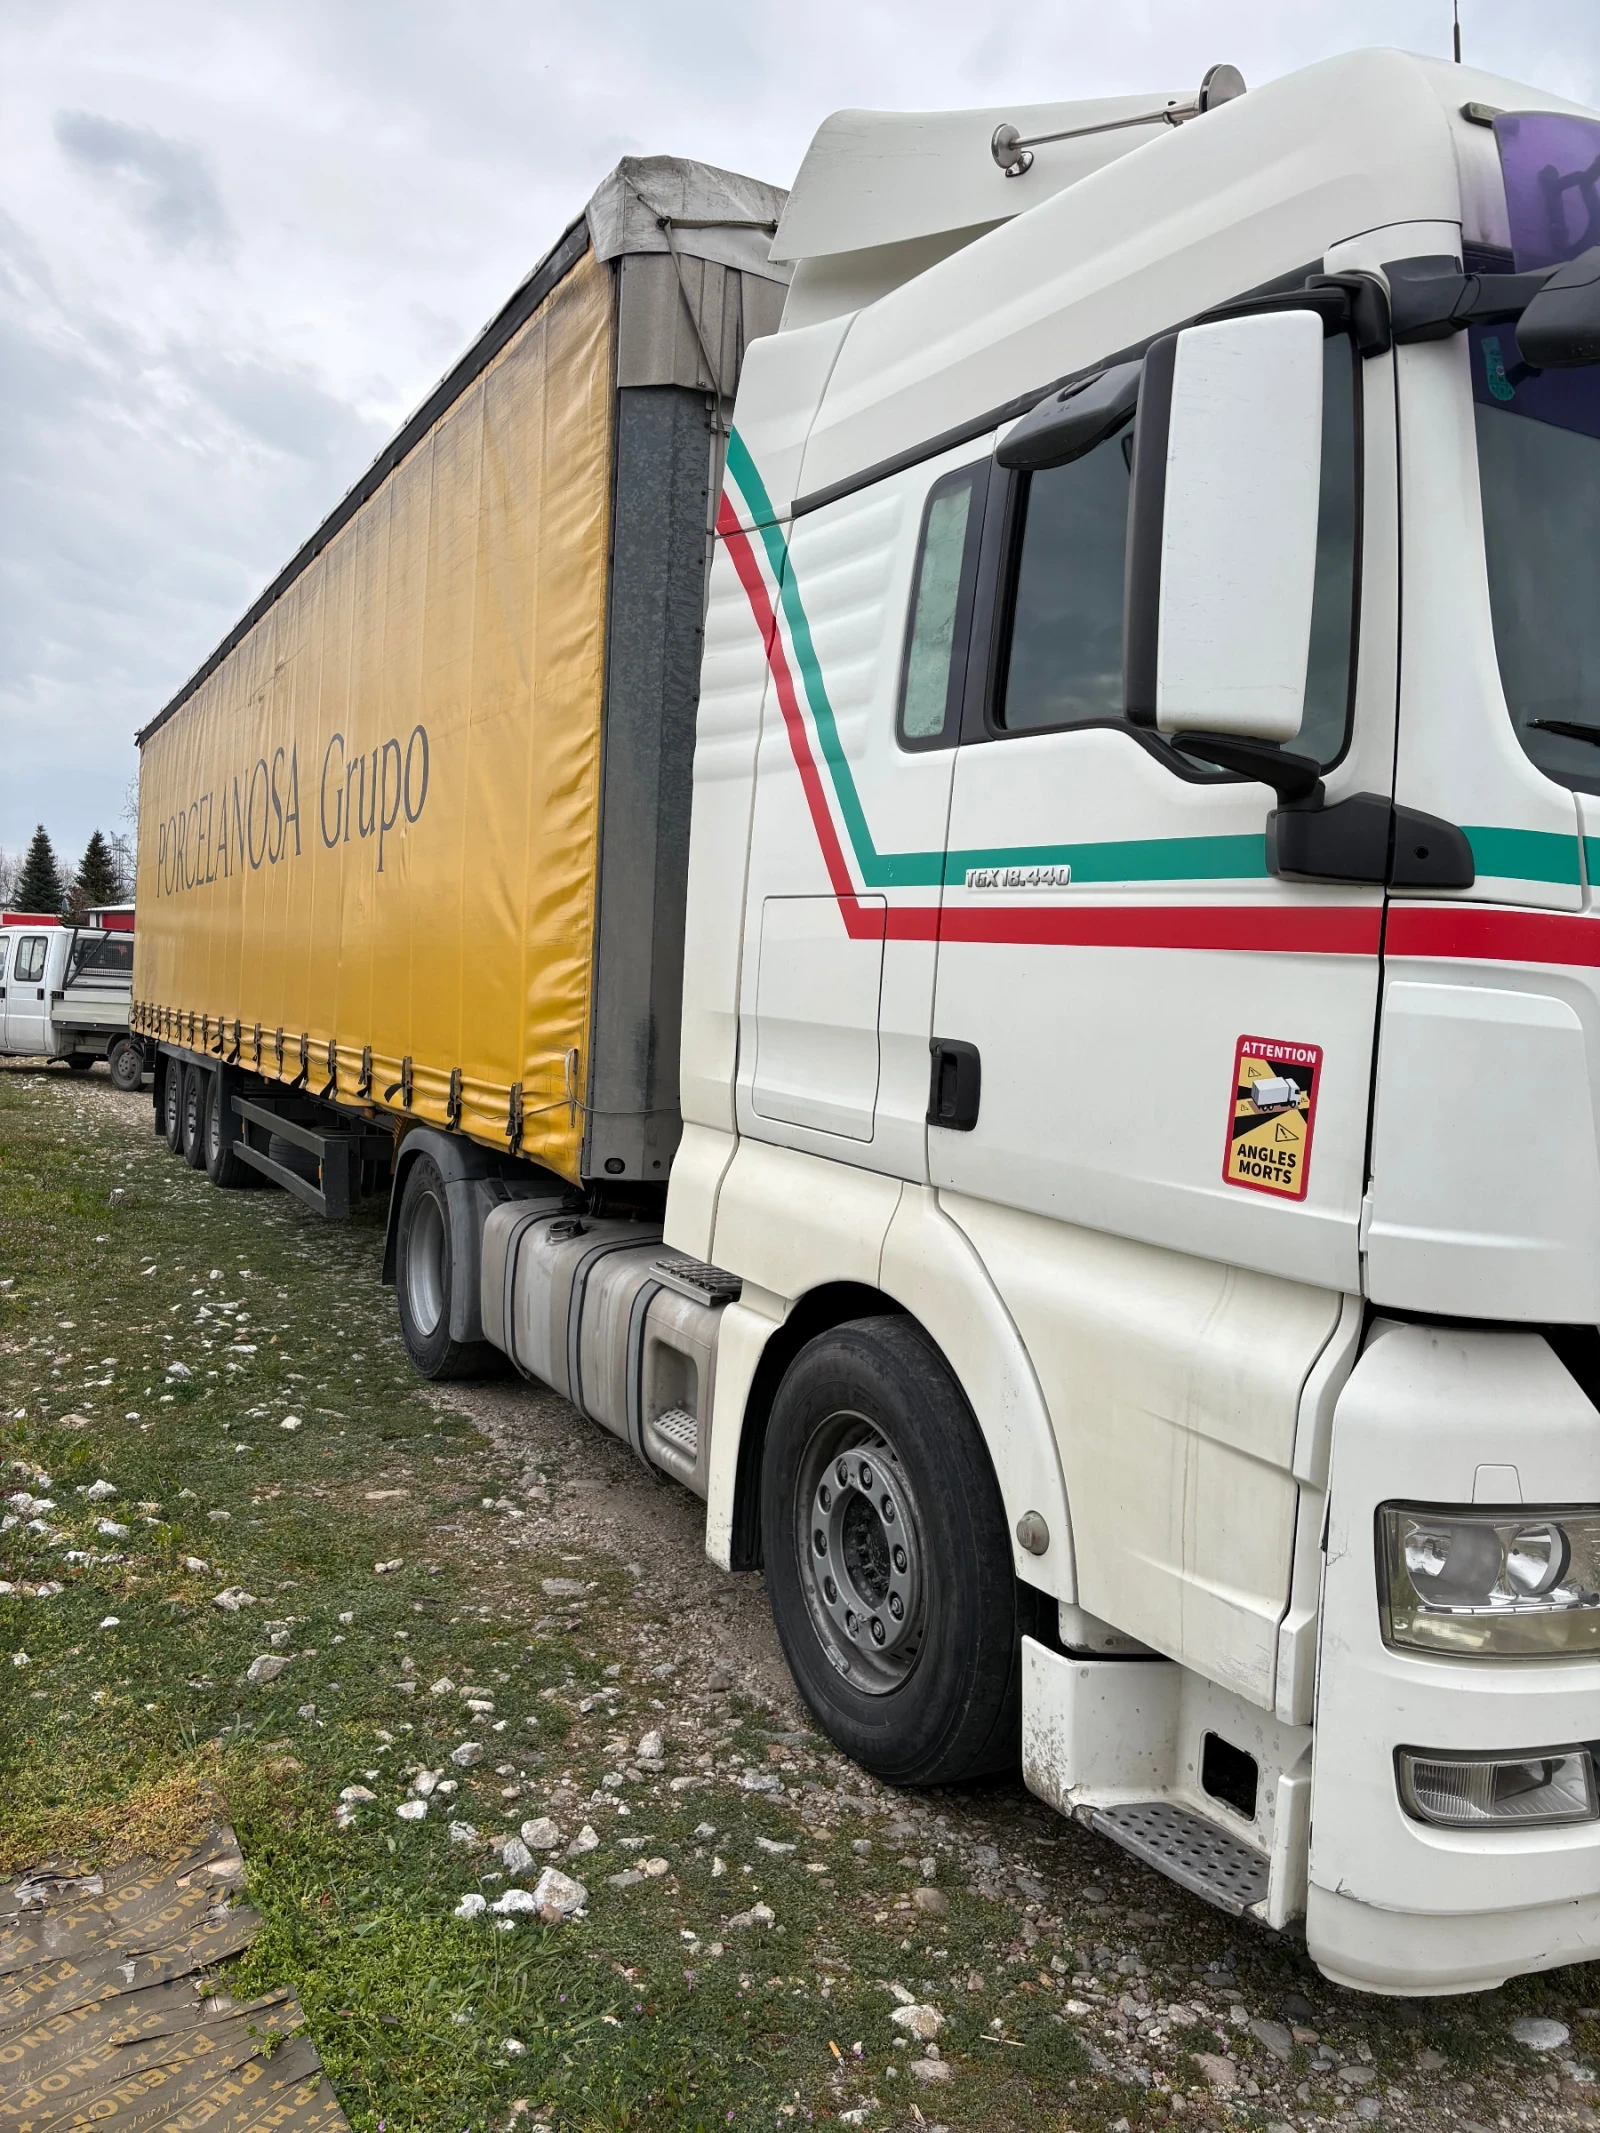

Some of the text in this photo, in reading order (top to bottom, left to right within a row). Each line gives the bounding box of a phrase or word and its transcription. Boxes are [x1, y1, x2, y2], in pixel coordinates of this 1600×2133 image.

[156, 724, 429, 898] PORCELANOSA Grupo
[1242, 1041, 1316, 1064] ATTENTION
[1237, 1143, 1297, 1168] ANGLES
[1238, 1160, 1292, 1185] MORTS
